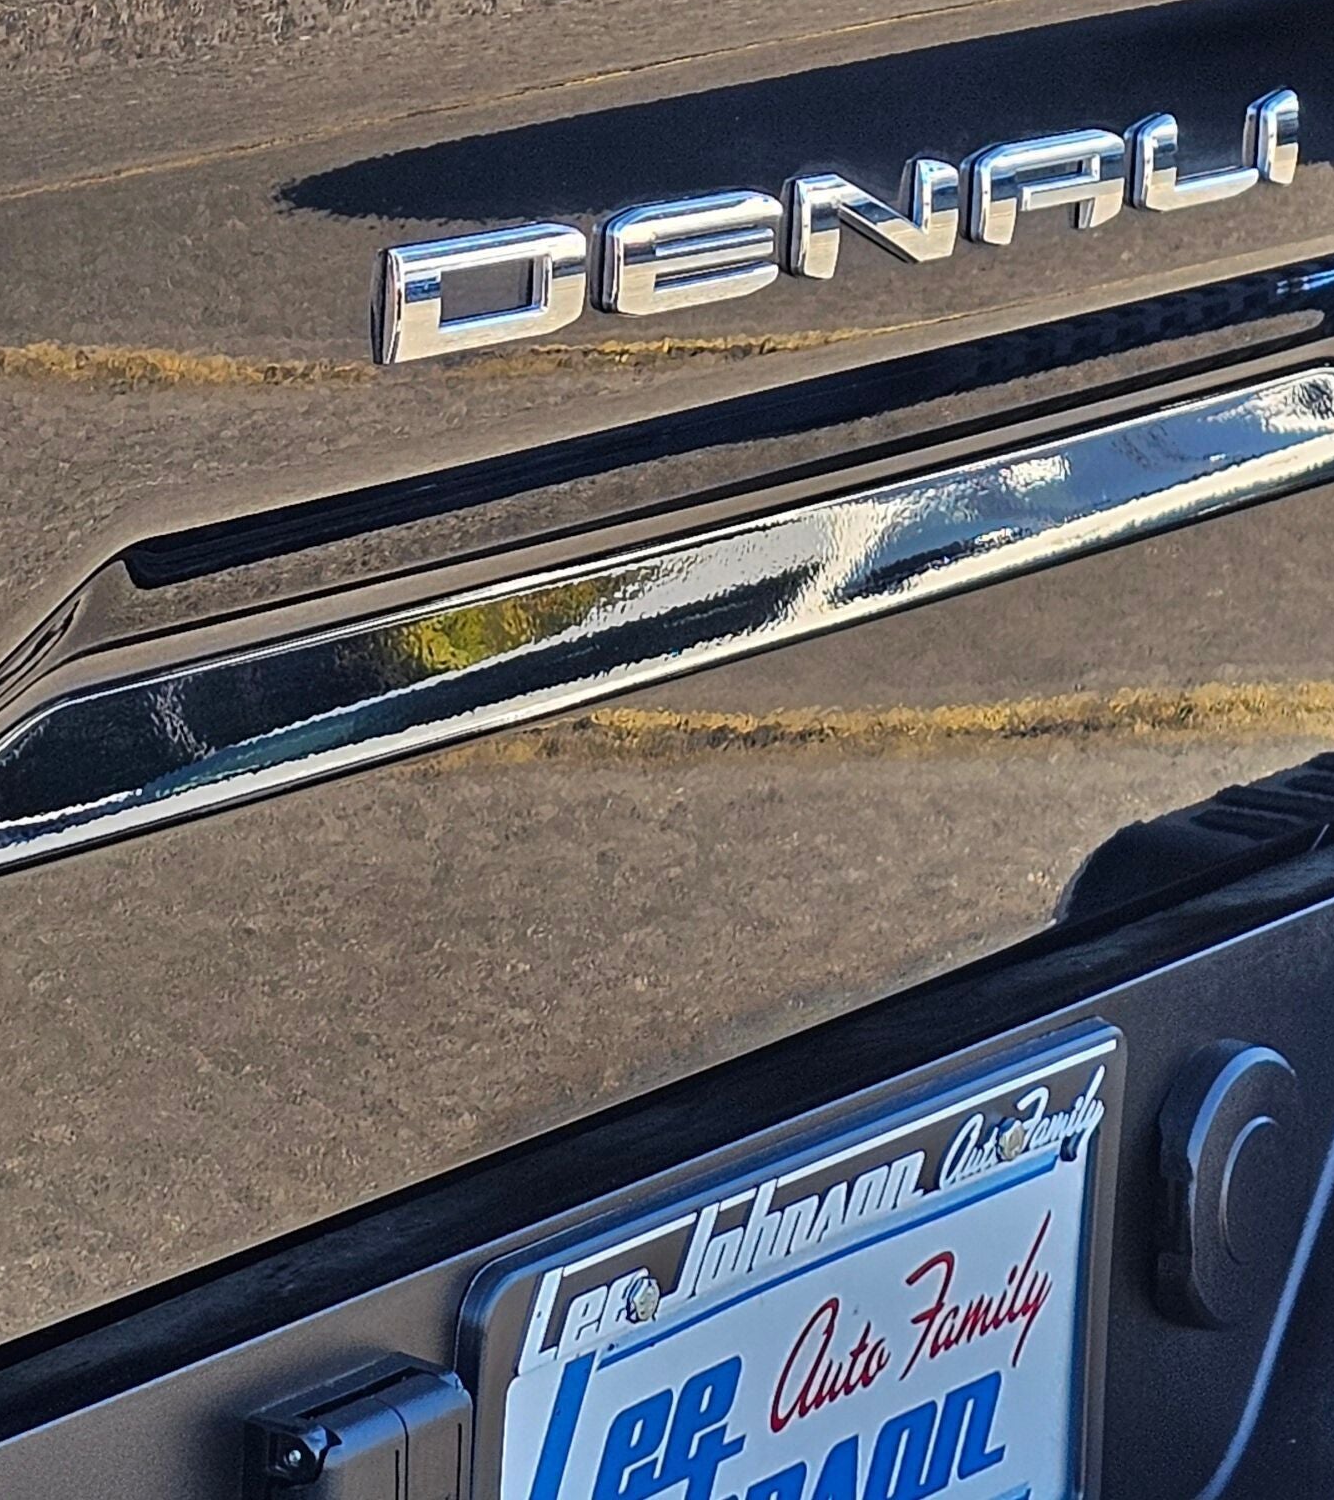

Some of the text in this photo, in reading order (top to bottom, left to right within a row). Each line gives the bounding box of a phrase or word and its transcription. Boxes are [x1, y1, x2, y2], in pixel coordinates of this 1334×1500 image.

[371, 86, 1299, 364] DENALI
[661, 1150, 925, 1303] Johnson
[939, 1113, 1017, 1190] Aut
[1017, 1065, 1106, 1158] Family
[528, 1352, 746, 1500] Lee
[770, 1209, 1053, 1433] Auto Family
